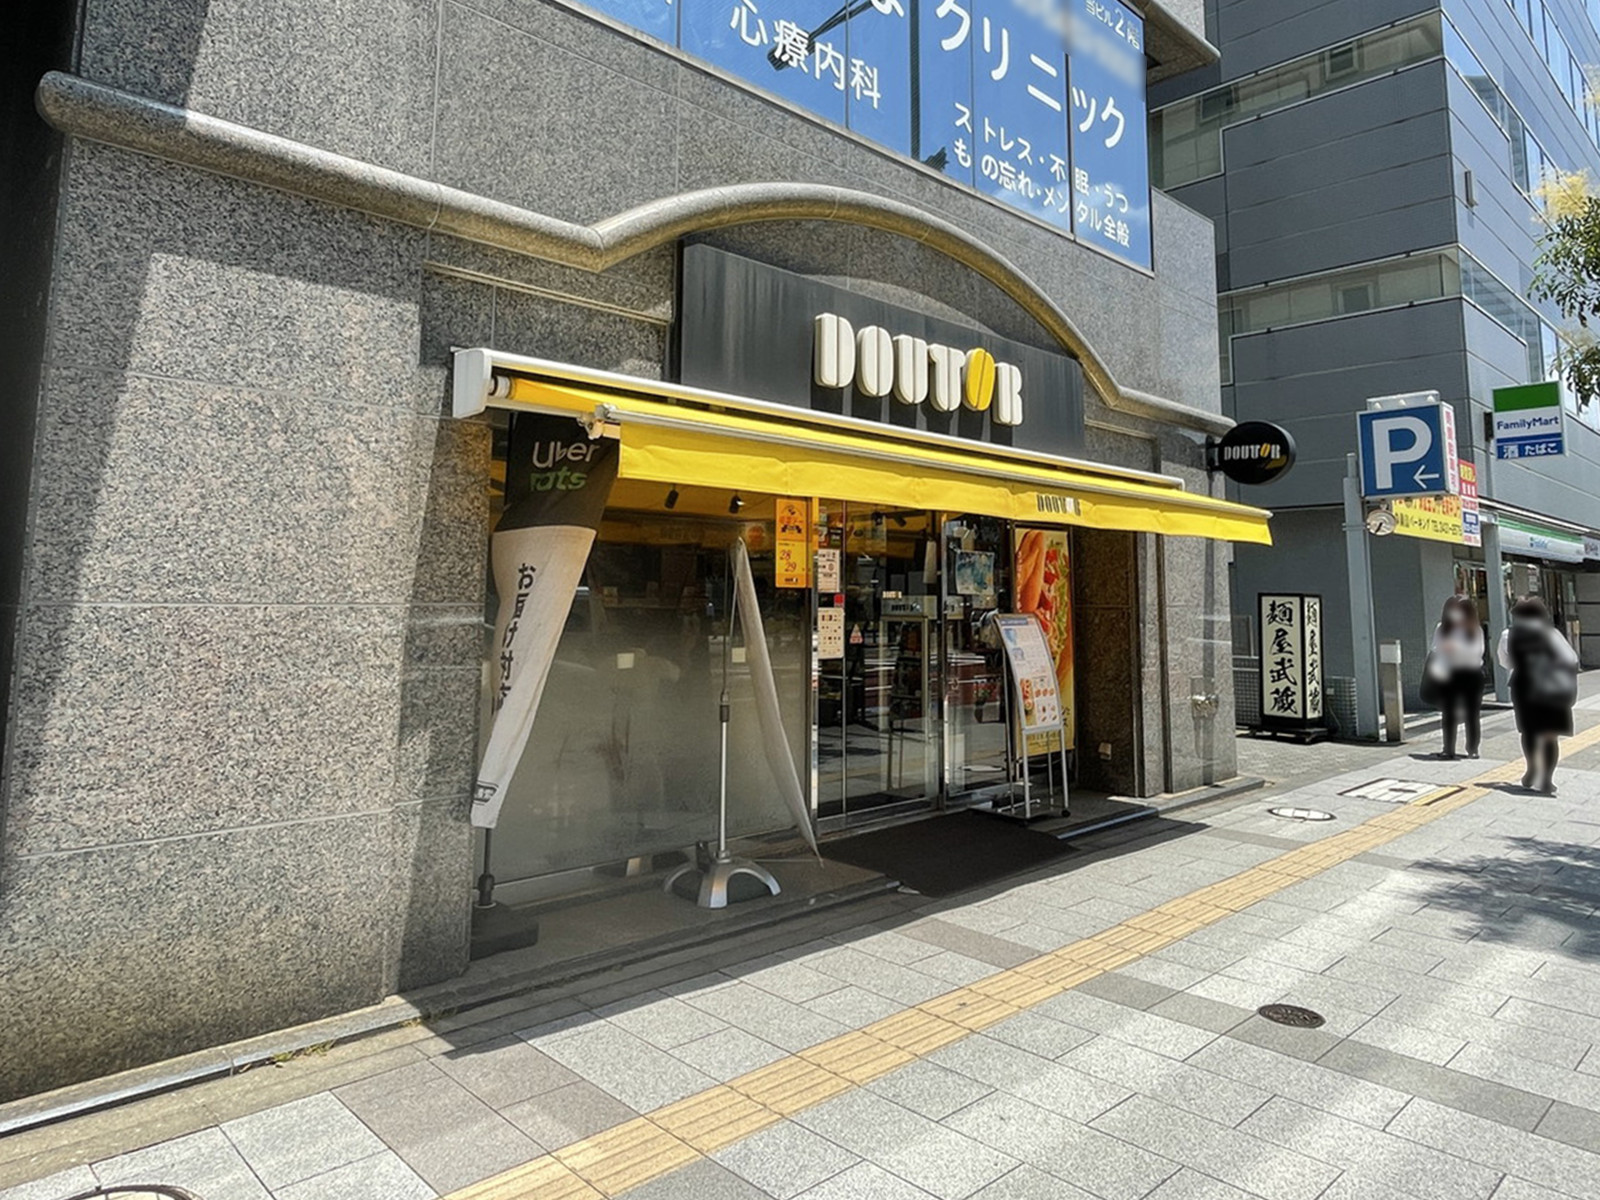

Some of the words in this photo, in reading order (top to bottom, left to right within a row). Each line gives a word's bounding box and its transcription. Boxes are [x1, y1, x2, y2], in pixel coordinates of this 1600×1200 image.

[729, 0, 881, 109] 心療内科
[815, 312, 1024, 426] DOUTOR
[1496, 416, 1560, 430] FamilyMart
[532, 441, 600, 468] Uber
[1223, 443, 1281, 460] DOUTOR
[1372, 416, 1433, 489] P
[1524, 443, 1559, 456] たばこ
[1266, 600, 1298, 715] 麺屋武蔵
